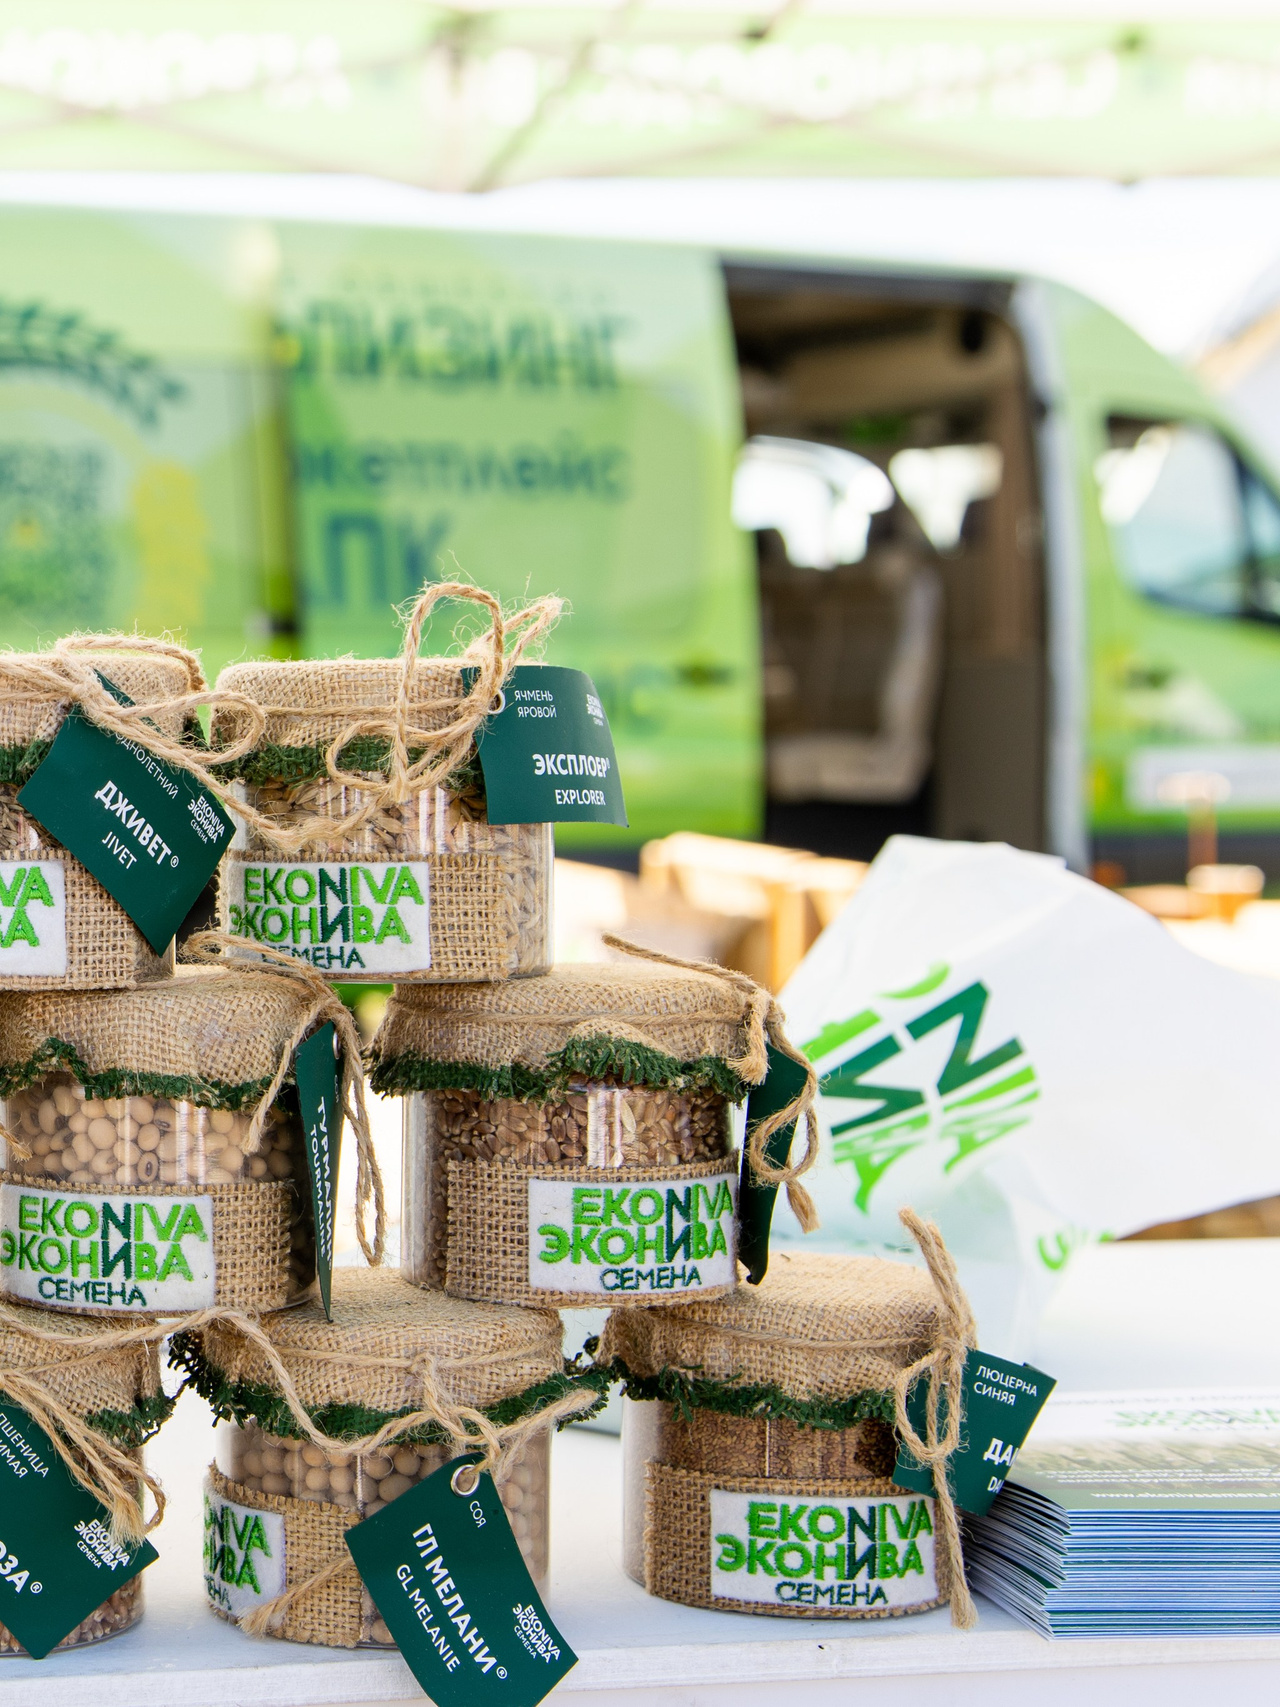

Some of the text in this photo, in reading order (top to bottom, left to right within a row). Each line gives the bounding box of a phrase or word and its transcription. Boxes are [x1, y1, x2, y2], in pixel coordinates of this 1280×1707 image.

[514, 690, 554, 702] ЯЧМЕНЬ
[517, 704, 557, 718] ЯРОВОЙ
[197, 795, 226, 838] EKONIVA
[555, 789, 606, 806] EXPLORER
[187, 799, 218, 844] ЭКОНИВА
[190, 818, 208, 845] СЕМЕНА
[102, 831, 138, 870] JIVET
[244, 866, 424, 905] EKONIVA
[229, 904, 412, 945] ЭКОНИВА
[18, 1195, 209, 1242] EKONIVA
[572, 1180, 734, 1226] EKONIVA
[0, 1230, 195, 1282] ЭКОНИВА
[537, 1221, 727, 1265] ЭКОНИВА
[38, 1276, 147, 1307] СЕМЕНА
[601, 1265, 702, 1291] СЕМЕНА
[973, 1382, 1016, 1406] СИНЯЯ
[976, 1365, 1038, 1397] ЛЮЦЕРНА
[469, 1500, 486, 1528] СОЯ
[747, 1499, 934, 1543] EKONIVA
[74, 1520, 118, 1571] ЭКОНИВА
[77, 1540, 102, 1569] СЕМЕНА
[412, 1523, 439, 1558] ГЛ
[715, 1533, 924, 1581] ЭКОНИВА
[775, 1581, 888, 1606] СЕМЕНА
[396, 1564, 461, 1673] GL MELANIE
[512, 1603, 553, 1664] ЭКОНИВА
[522, 1604, 561, 1661] EKONIVA
[513, 1625, 537, 1659] СЕМЕНА
